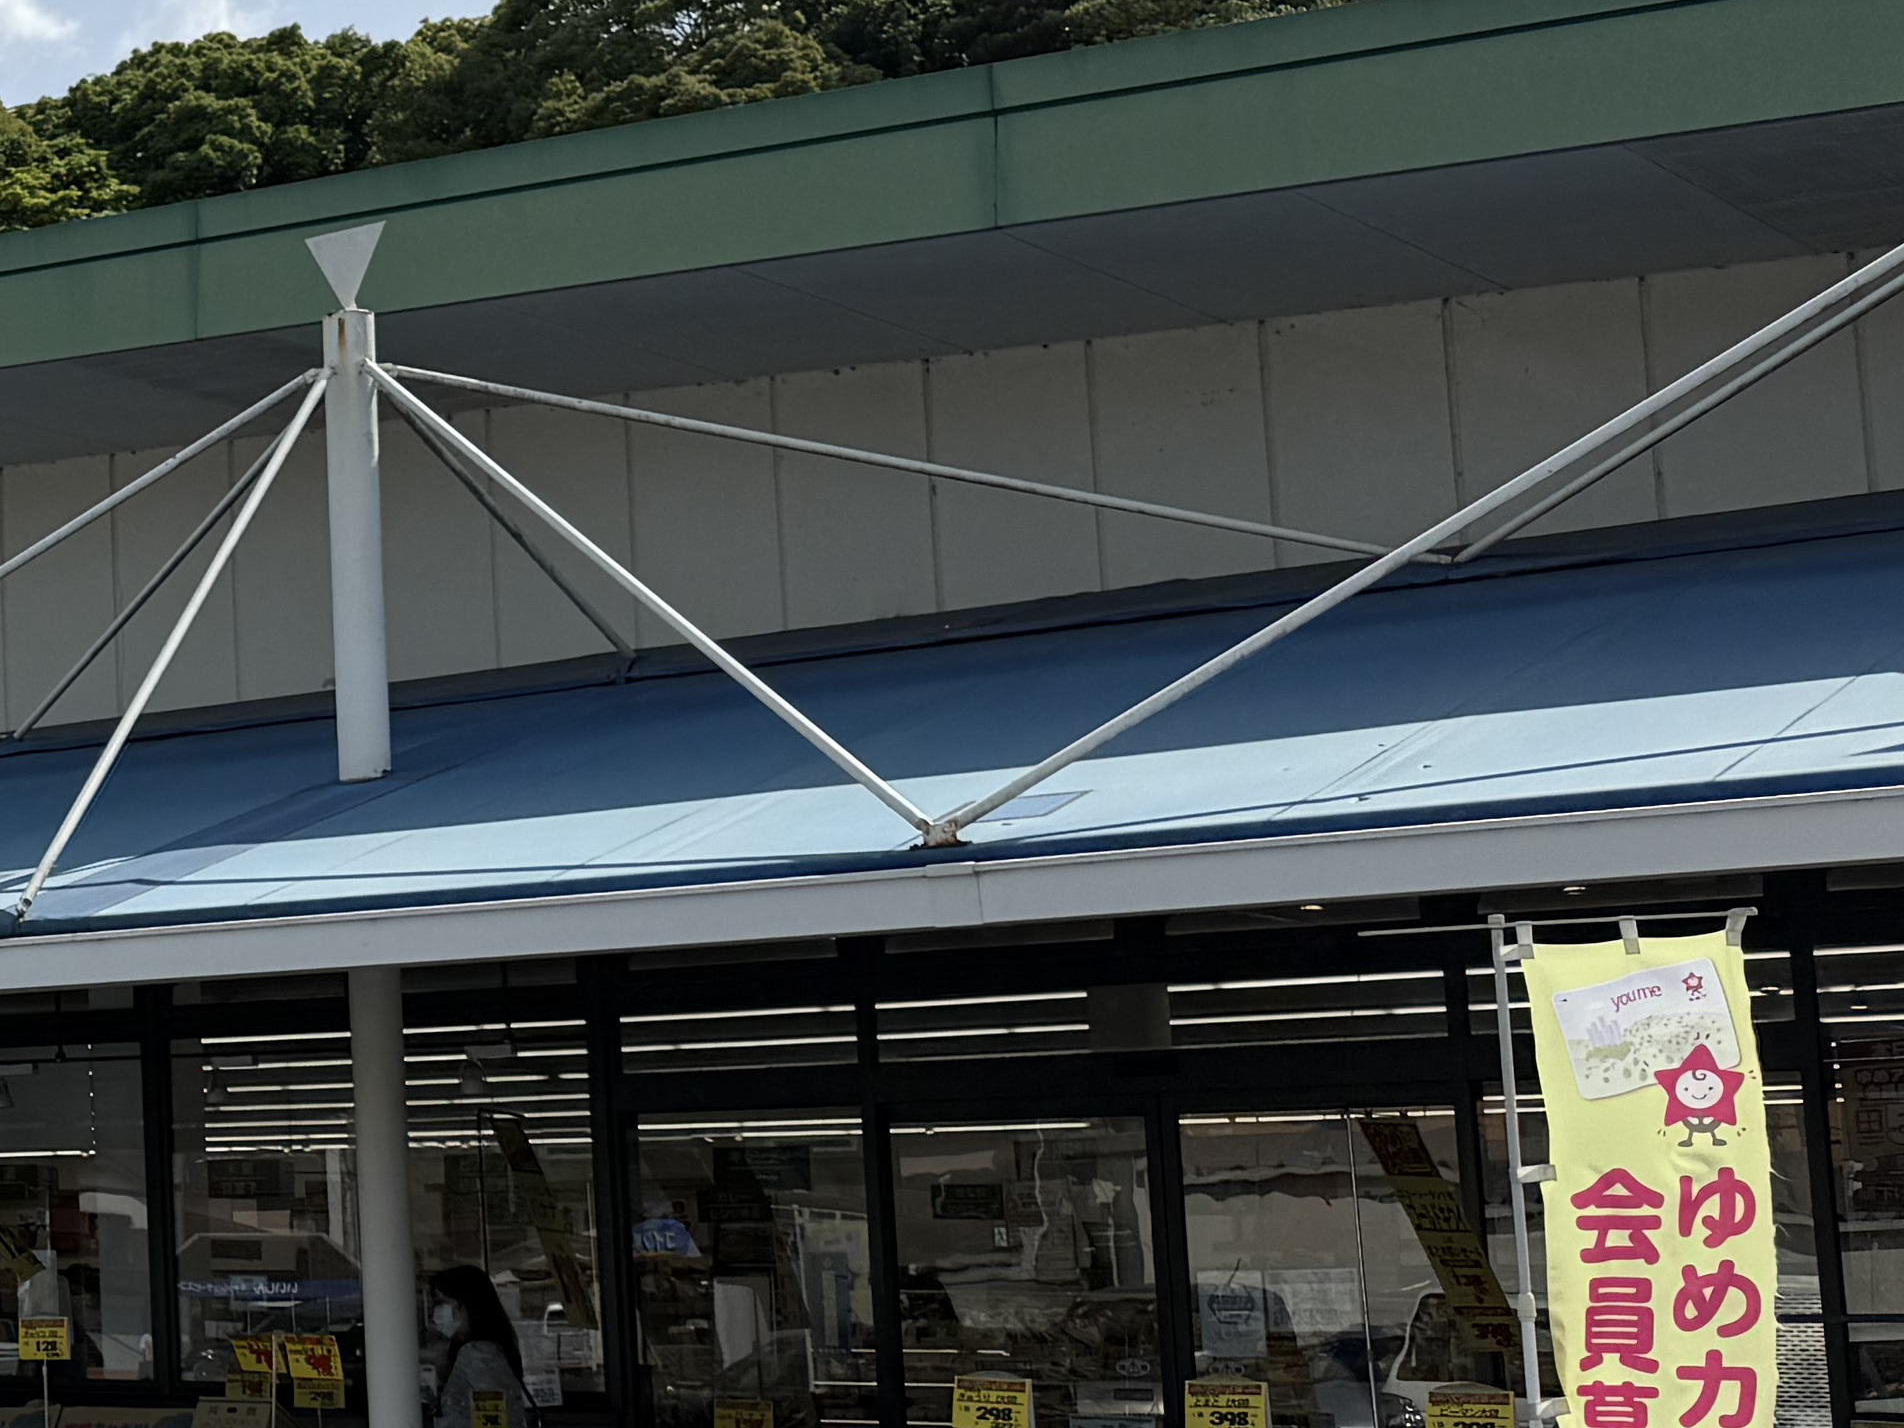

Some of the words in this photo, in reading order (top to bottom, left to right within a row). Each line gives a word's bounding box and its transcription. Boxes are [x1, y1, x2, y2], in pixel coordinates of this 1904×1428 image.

[1611, 985, 1662, 1012] youme
[976, 1406, 1013, 1421] 298
[1209, 1411, 1249, 1426] 398
